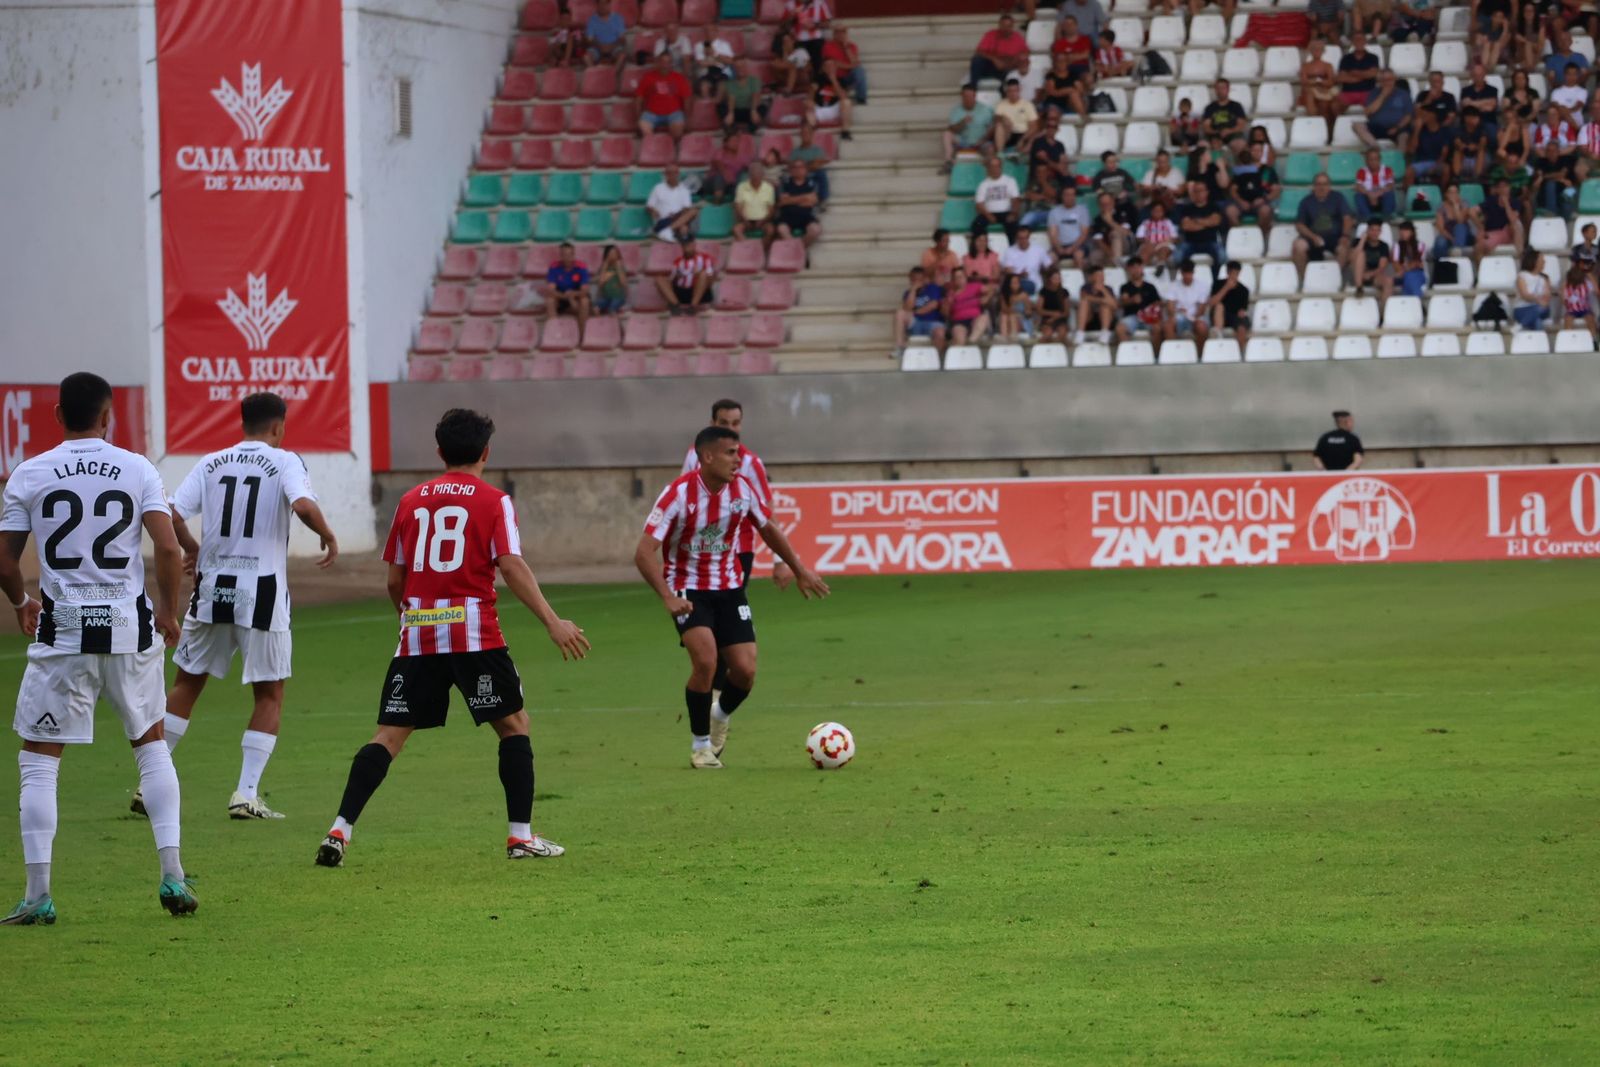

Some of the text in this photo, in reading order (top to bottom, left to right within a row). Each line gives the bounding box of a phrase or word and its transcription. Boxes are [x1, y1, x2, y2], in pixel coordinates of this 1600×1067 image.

[176, 147, 331, 172] CAJA RURAL
[204, 176, 304, 191] DE ZAMORA
[181, 357, 335, 382] CAJA RURAL
[209, 386, 232, 400] DE
[53, 459, 121, 480] LLÁCER
[205, 453, 234, 474] JAVI
[432, 483, 475, 495] MACHO
[219, 475, 261, 538] 11
[1091, 480, 1295, 524] FUNDACIÓN
[1486, 473, 1551, 537] La
[42, 490, 134, 569] 22
[413, 506, 469, 572] 18
[815, 532, 1012, 572] ZAMORA
[1090, 524, 1295, 567] ZAMORACF
[1507, 539, 1528, 556] El
[68, 617, 82, 627] DE
[69, 608, 120, 617] GOBIERNO
[468, 696, 502, 706] ZAMORA
